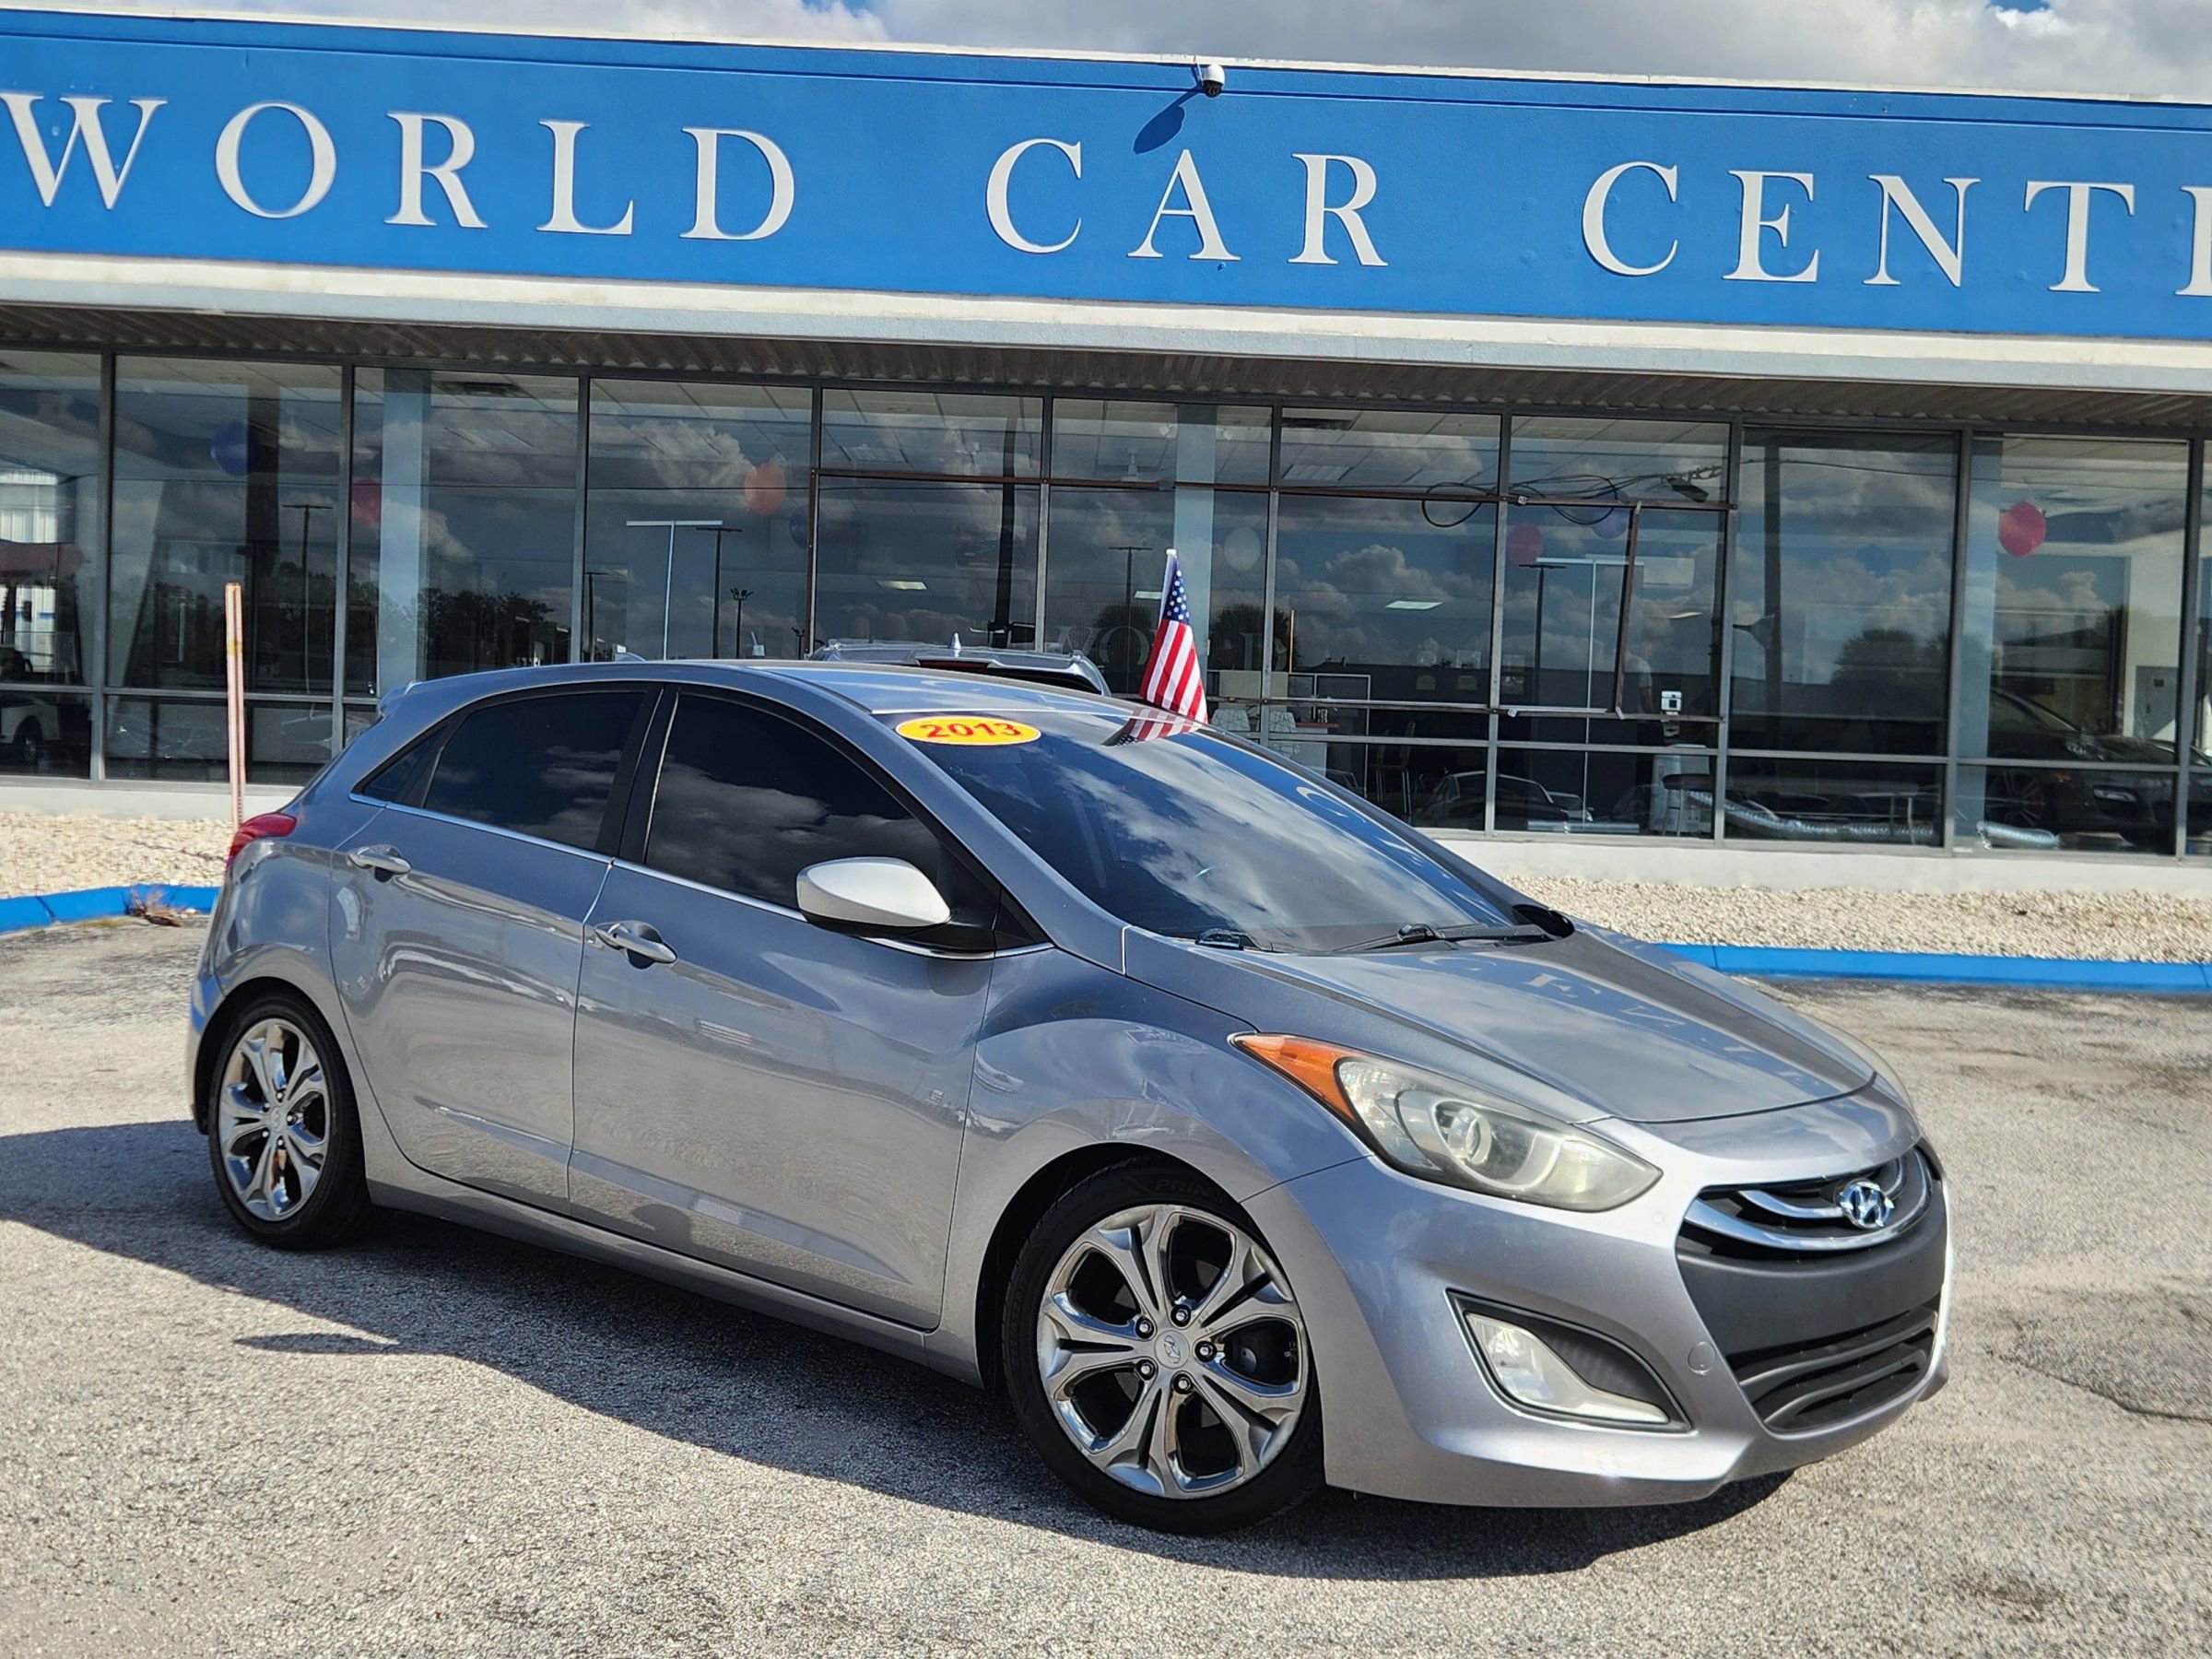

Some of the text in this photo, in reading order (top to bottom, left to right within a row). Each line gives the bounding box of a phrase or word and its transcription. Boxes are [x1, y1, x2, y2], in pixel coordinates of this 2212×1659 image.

[0, 92, 795, 241] WORLD
[985, 138, 1389, 267] CAR
[919, 723, 1021, 738] 2013
